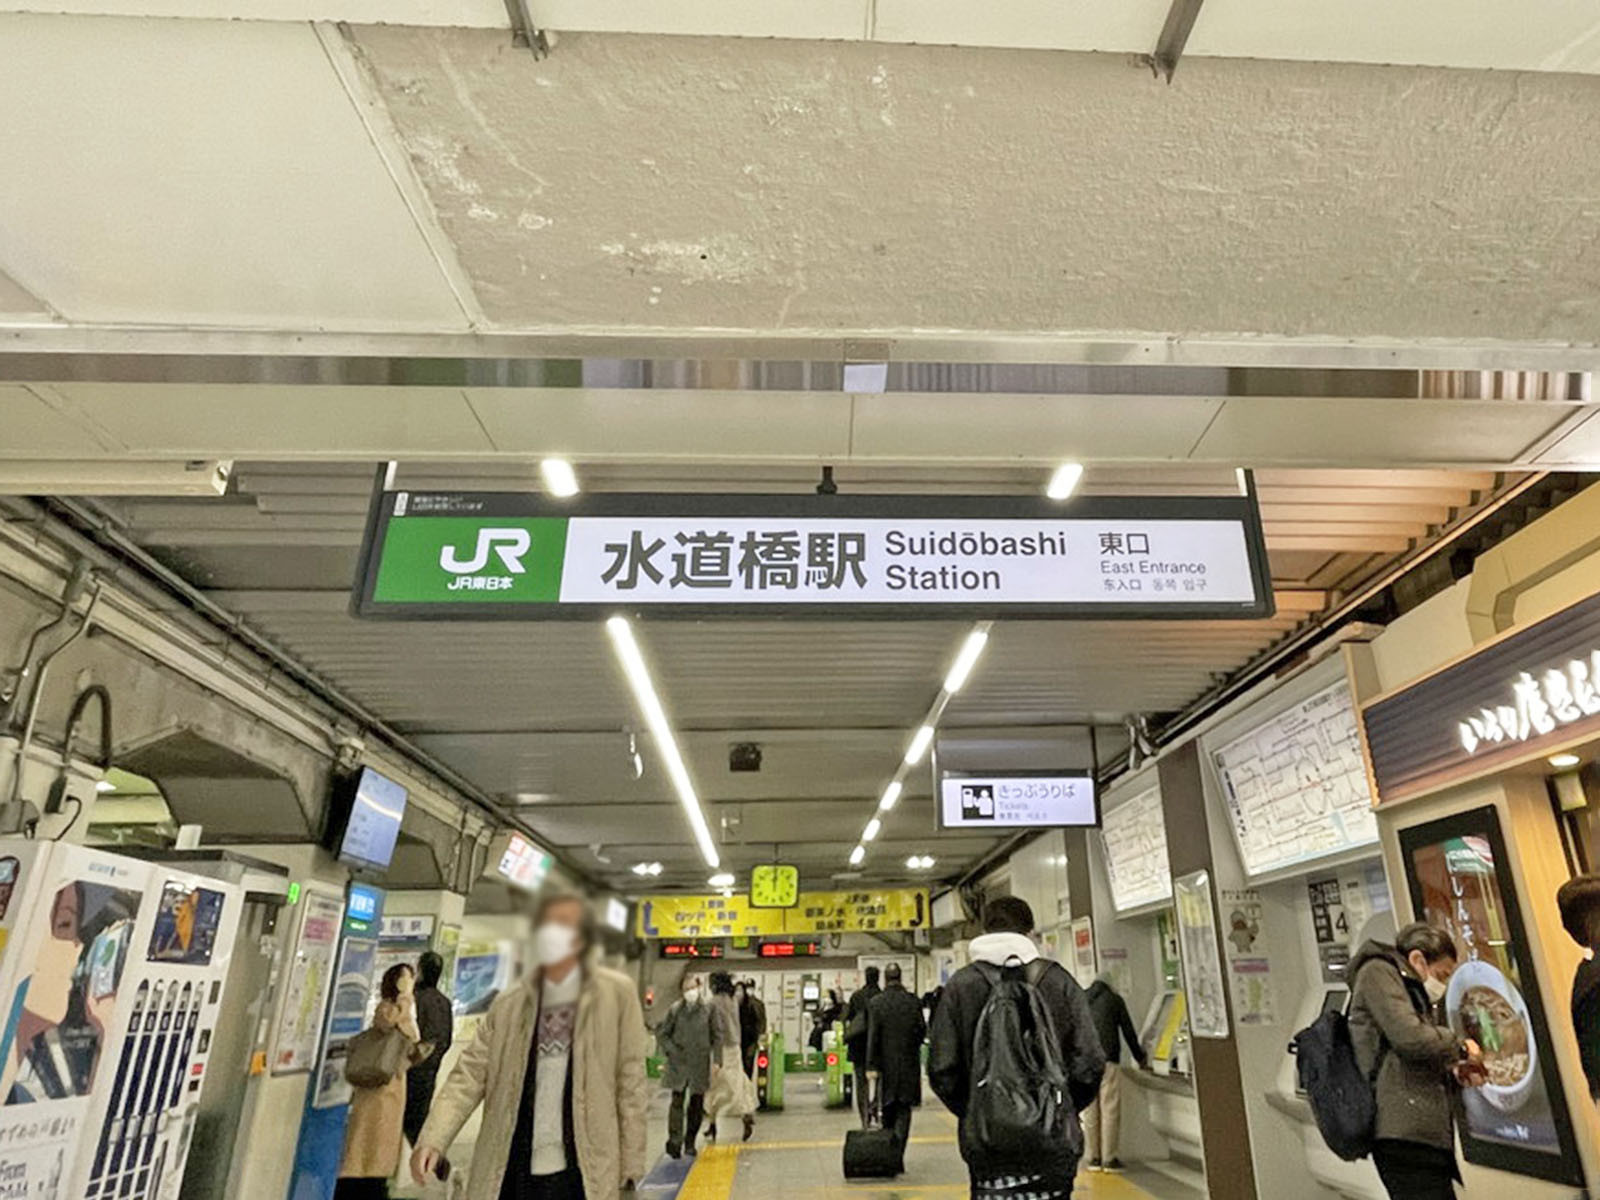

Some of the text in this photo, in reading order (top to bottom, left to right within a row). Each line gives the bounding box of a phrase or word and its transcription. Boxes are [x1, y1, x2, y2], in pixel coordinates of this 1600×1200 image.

[440, 528, 531, 574] JR
[885, 531, 1066, 556] Suidōbashi
[1099, 533, 1151, 557] 東口
[600, 530, 868, 590] 水道橋駅
[1101, 561, 1207, 575] East Entrance
[447, 576, 514, 591] JR東日本
[885, 565, 1001, 590] Station
[998, 783, 1076, 799] きっぷうりば
[1335, 911, 1350, 934] 4
